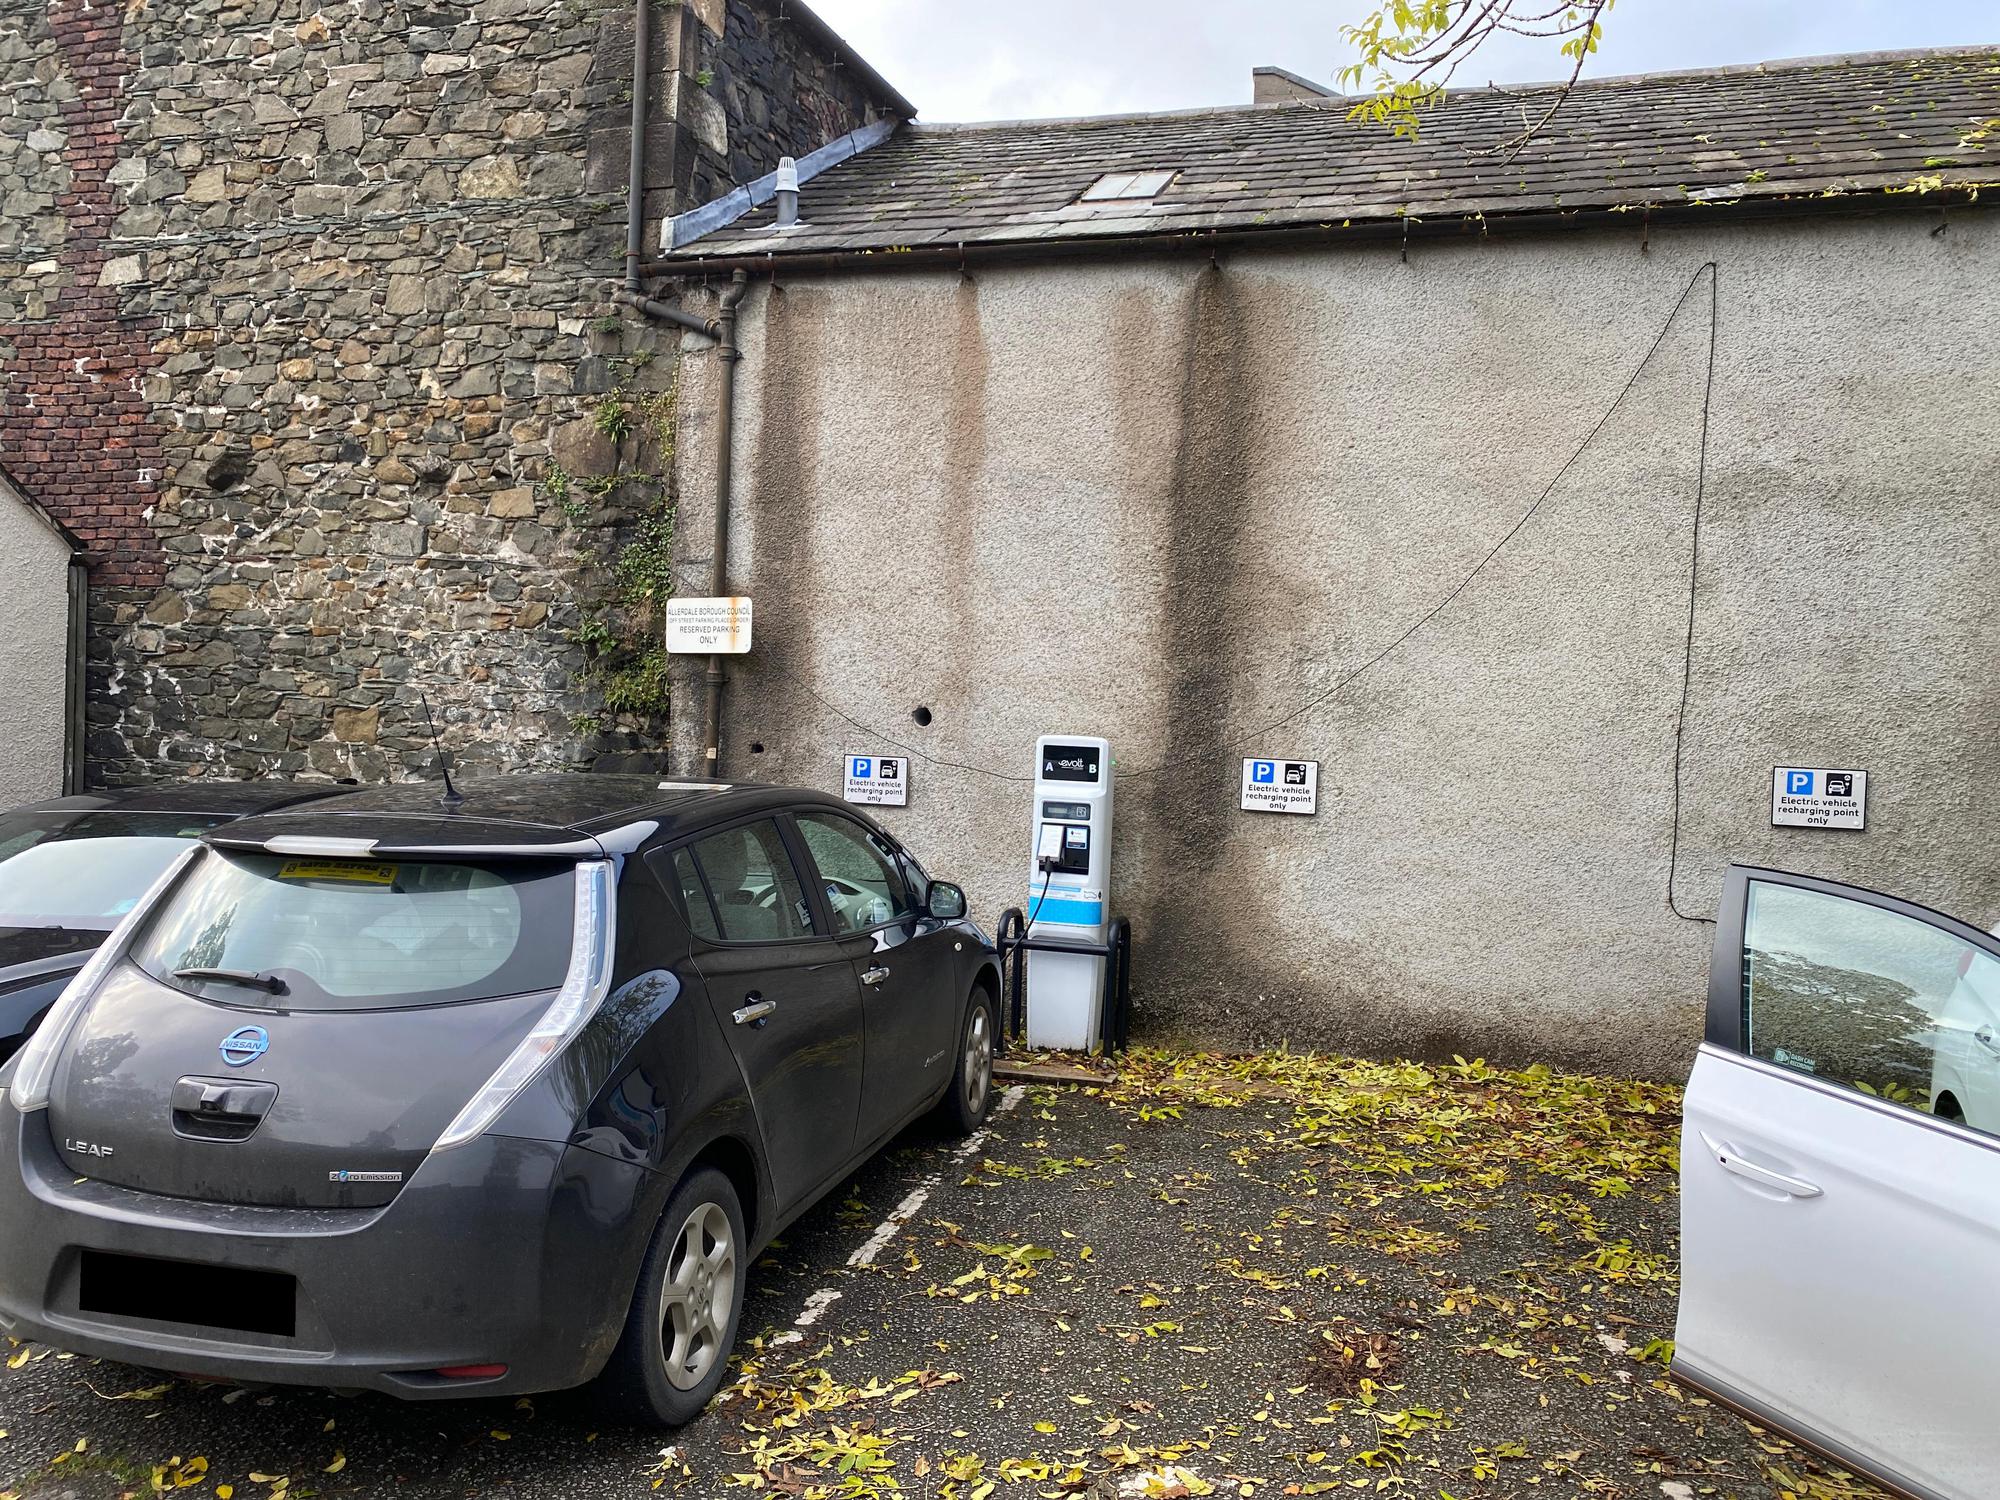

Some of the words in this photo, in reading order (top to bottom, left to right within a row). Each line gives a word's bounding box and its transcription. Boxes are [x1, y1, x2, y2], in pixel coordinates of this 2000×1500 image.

[668, 607, 698, 616] ALLERDALE
[698, 607, 726, 616] BOROUGH
[726, 607, 750, 616] COUNCIL
[680, 626, 712, 634] RESERVED
[712, 626, 740, 634] PARKING
[699, 636, 718, 644] ONLY
[856, 760, 868, 776] P
[1045, 761, 1054, 772] A
[1088, 763, 1097, 774] B
[1256, 764, 1270, 781] P
[849, 778, 876, 787] Electric
[1792, 773, 1809, 793] P
[847, 787, 884, 796] recharging
[1248, 784, 1280, 793] Electric
[1281, 786, 1310, 795] vehicle
[1245, 792, 1288, 802] recharging
[1290, 795, 1312, 804] point
[1780, 796, 1820, 806] Electric
[1822, 798, 1858, 808] vehicle
[1269, 802, 1287, 810] only
[1778, 806, 1831, 817] recharging
[1833, 808, 1860, 818] point
[1807, 816, 1829, 826] only
[222, 1040, 262, 1050] NISSAN
[1790, 1054, 1804, 1062] DASH
[65, 1138, 114, 1158] LEAF
[360, 1173, 400, 1181] Emission
